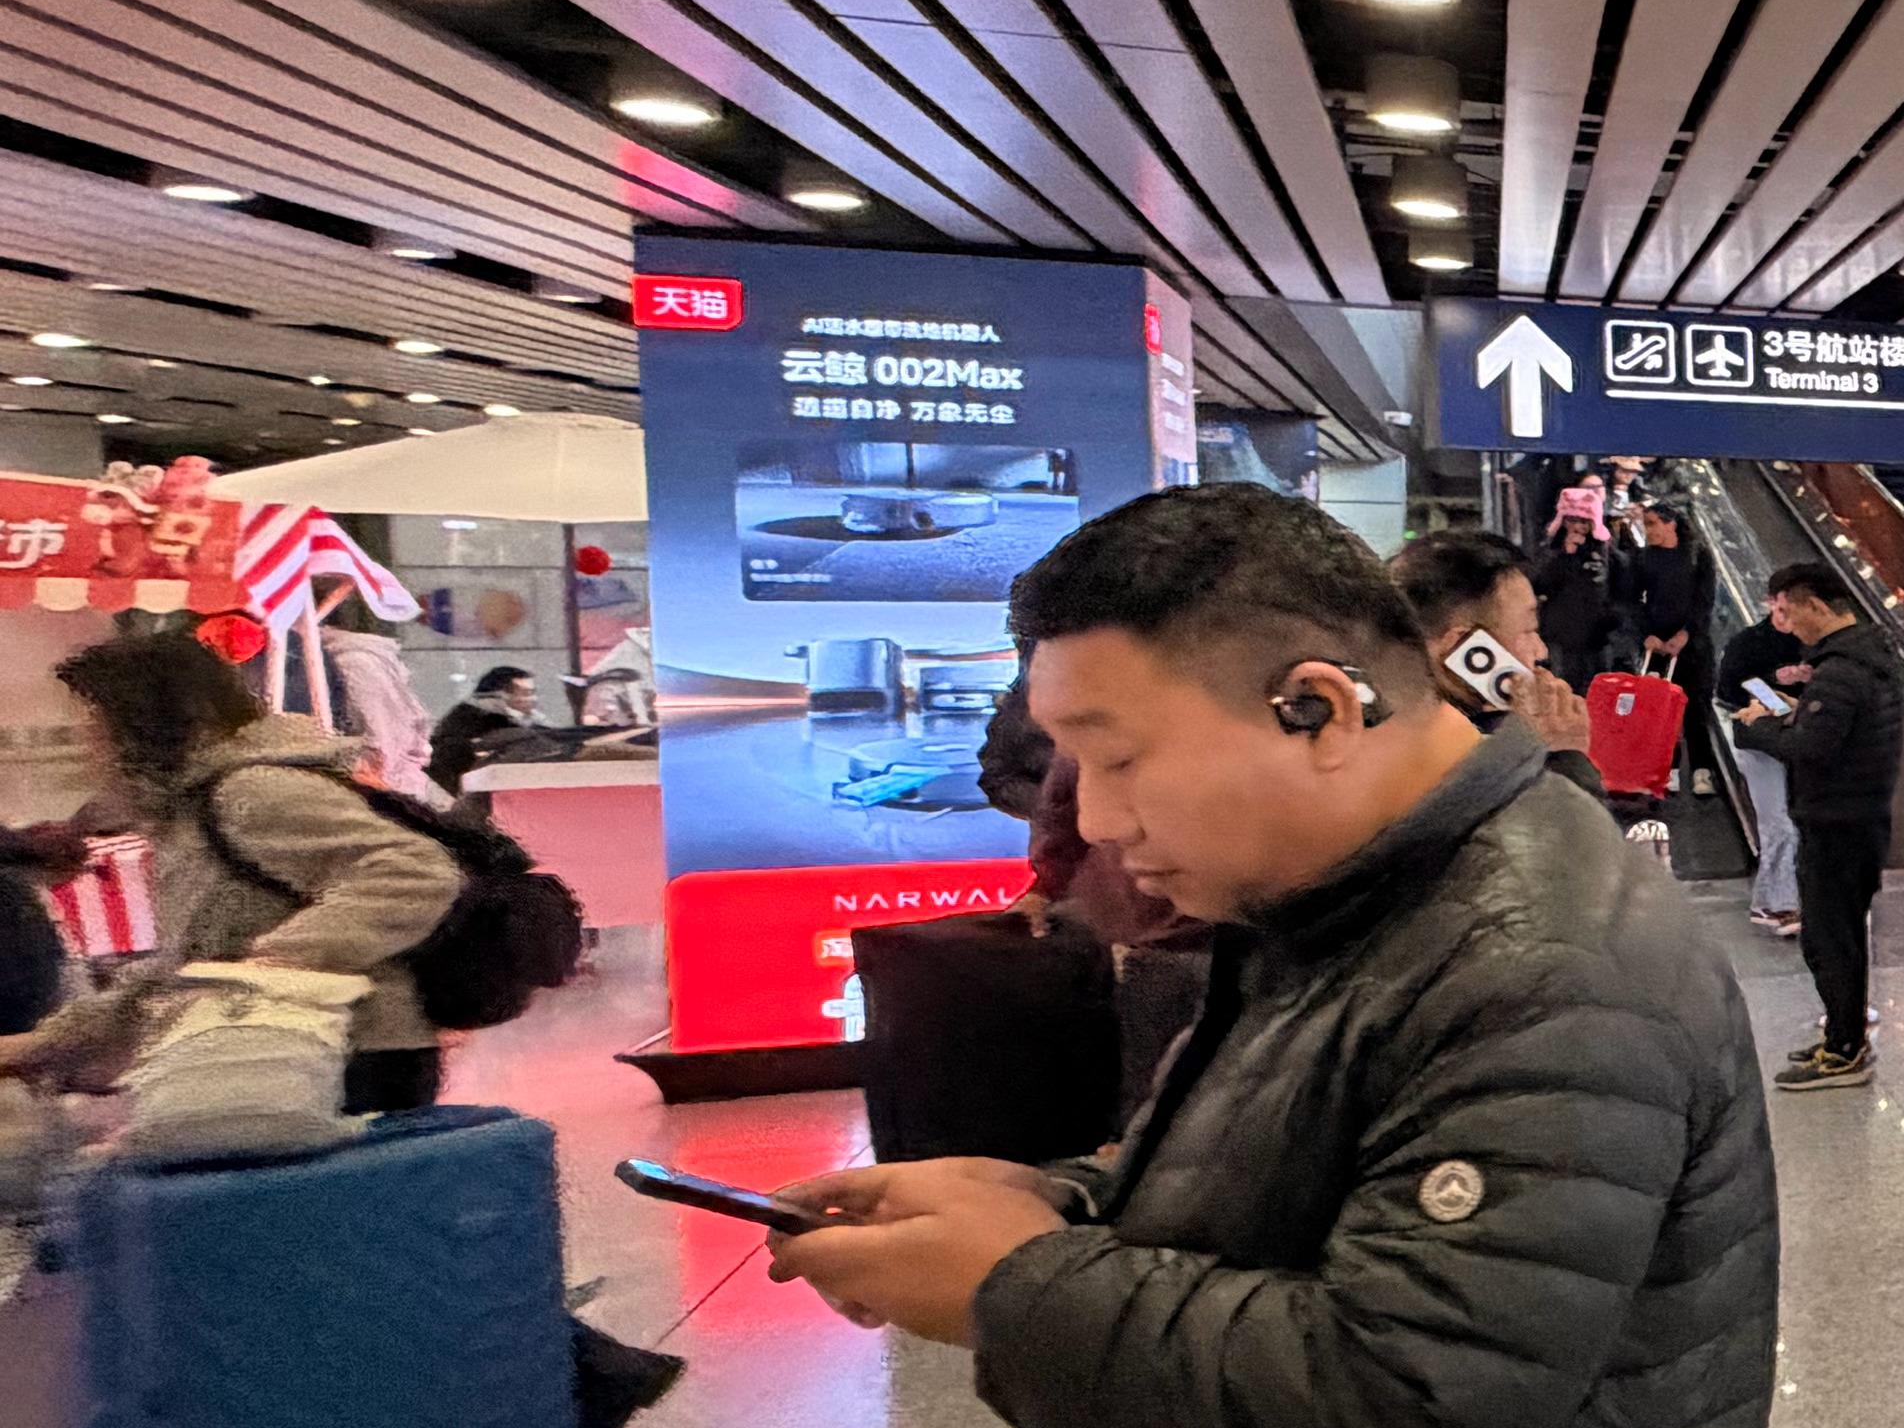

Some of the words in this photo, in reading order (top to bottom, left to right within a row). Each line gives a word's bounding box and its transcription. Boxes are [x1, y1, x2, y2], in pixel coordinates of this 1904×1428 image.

[653, 286, 727, 319] 天猫
[781, 350, 868, 386] 云鲸
[873, 356, 1024, 390] 002Max
[1764, 367, 1860, 392] Terminal
[1862, 372, 1880, 394] 3
[834, 887, 1013, 912] NARWAL
